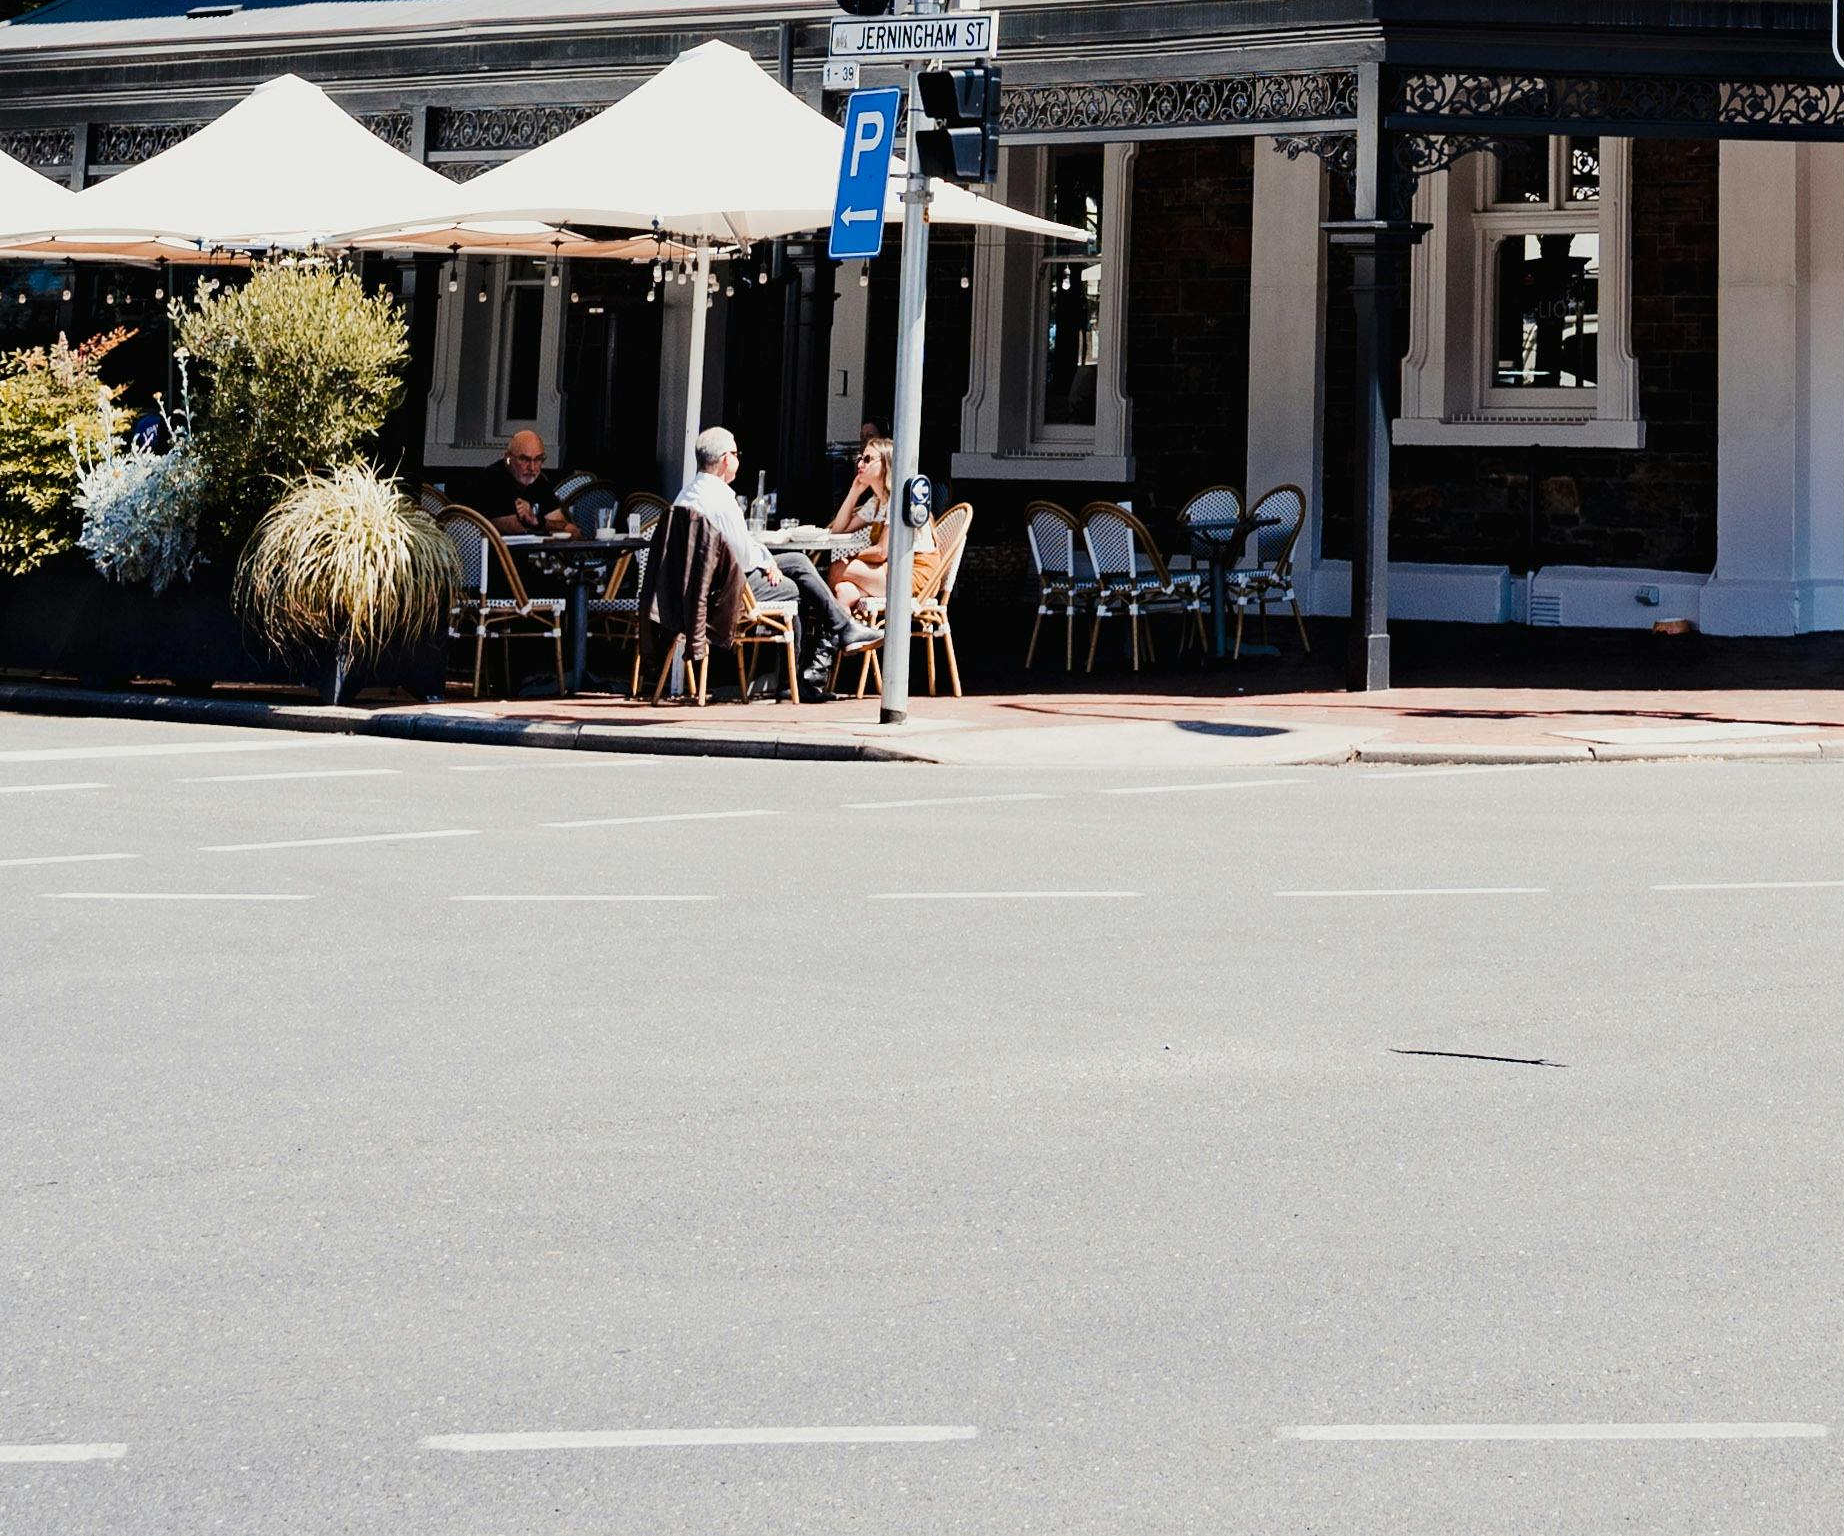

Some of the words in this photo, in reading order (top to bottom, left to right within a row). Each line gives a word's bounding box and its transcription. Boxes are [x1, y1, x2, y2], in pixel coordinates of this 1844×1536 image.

[857, 23, 957, 51] JERNINGHAM
[965, 22, 985, 47] ST
[842, 66, 854, 81] 39
[850, 110, 885, 177] P
